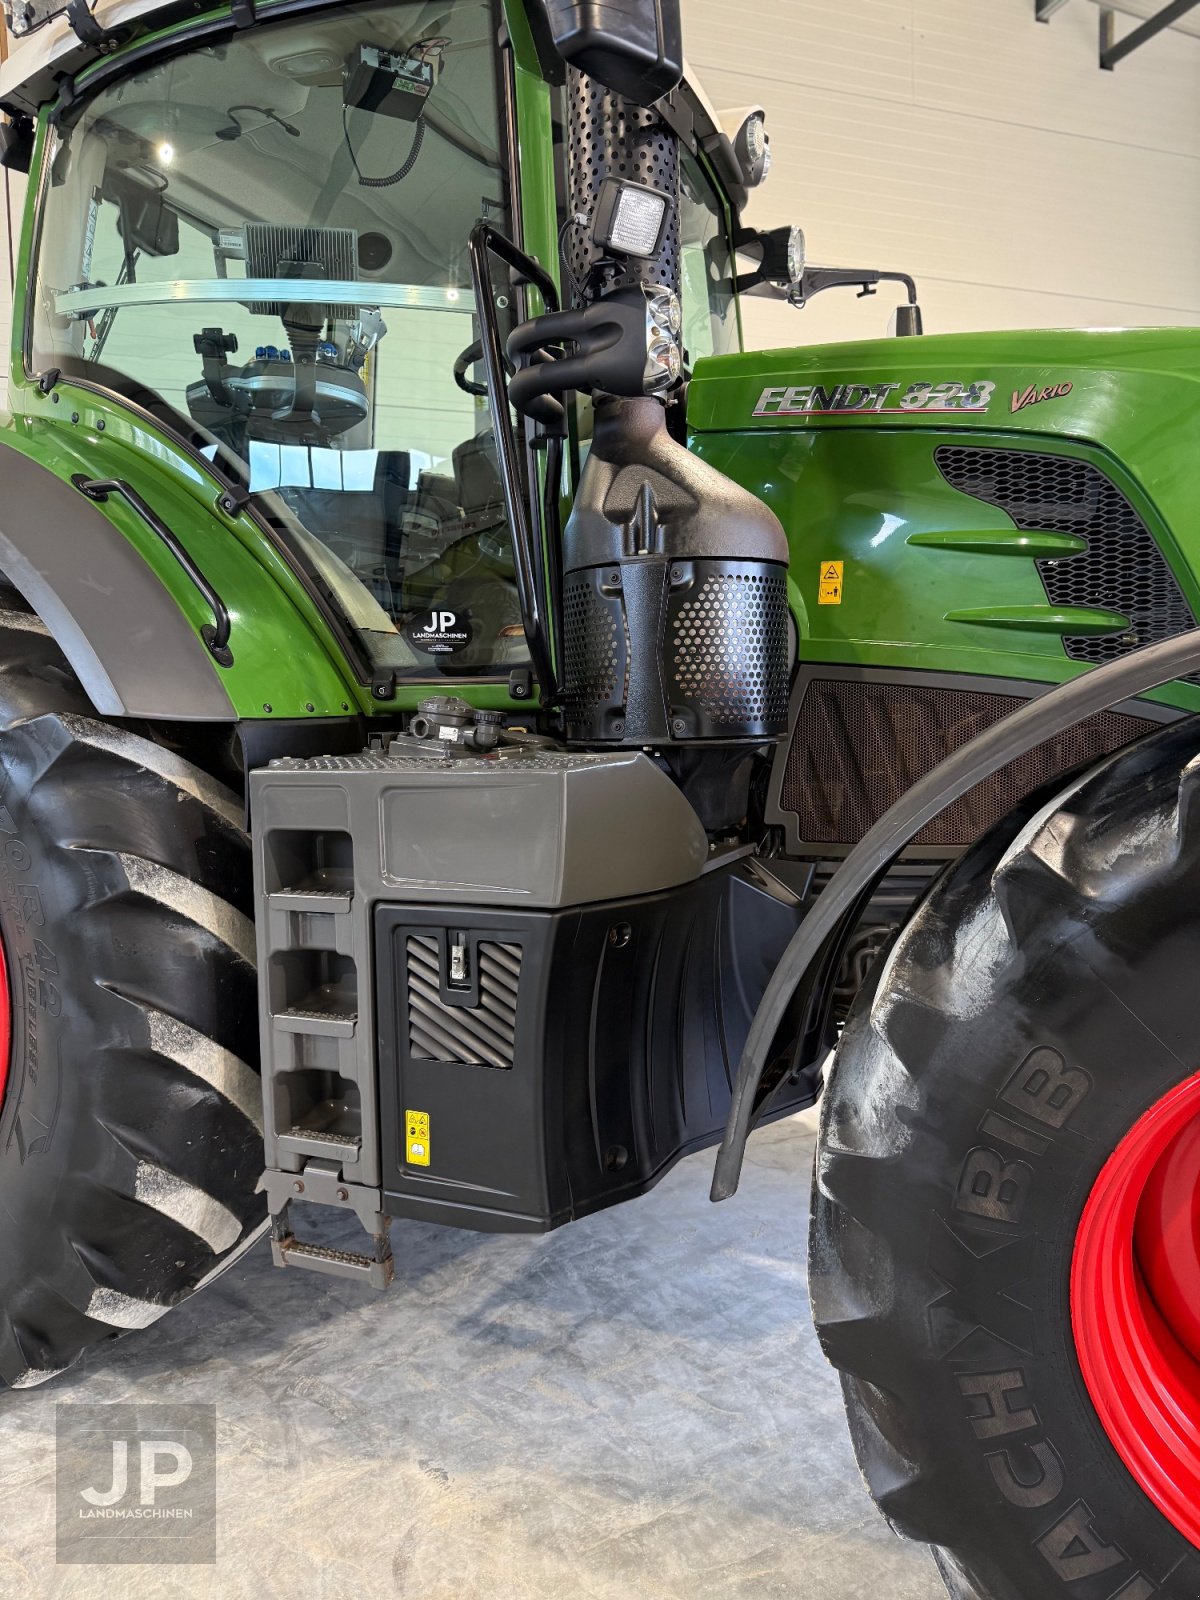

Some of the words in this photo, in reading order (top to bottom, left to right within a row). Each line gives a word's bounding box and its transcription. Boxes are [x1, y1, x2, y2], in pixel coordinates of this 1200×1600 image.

[754, 382, 901, 413] FENDT
[899, 380, 996, 409] 828
[423, 611, 456, 633] JP
